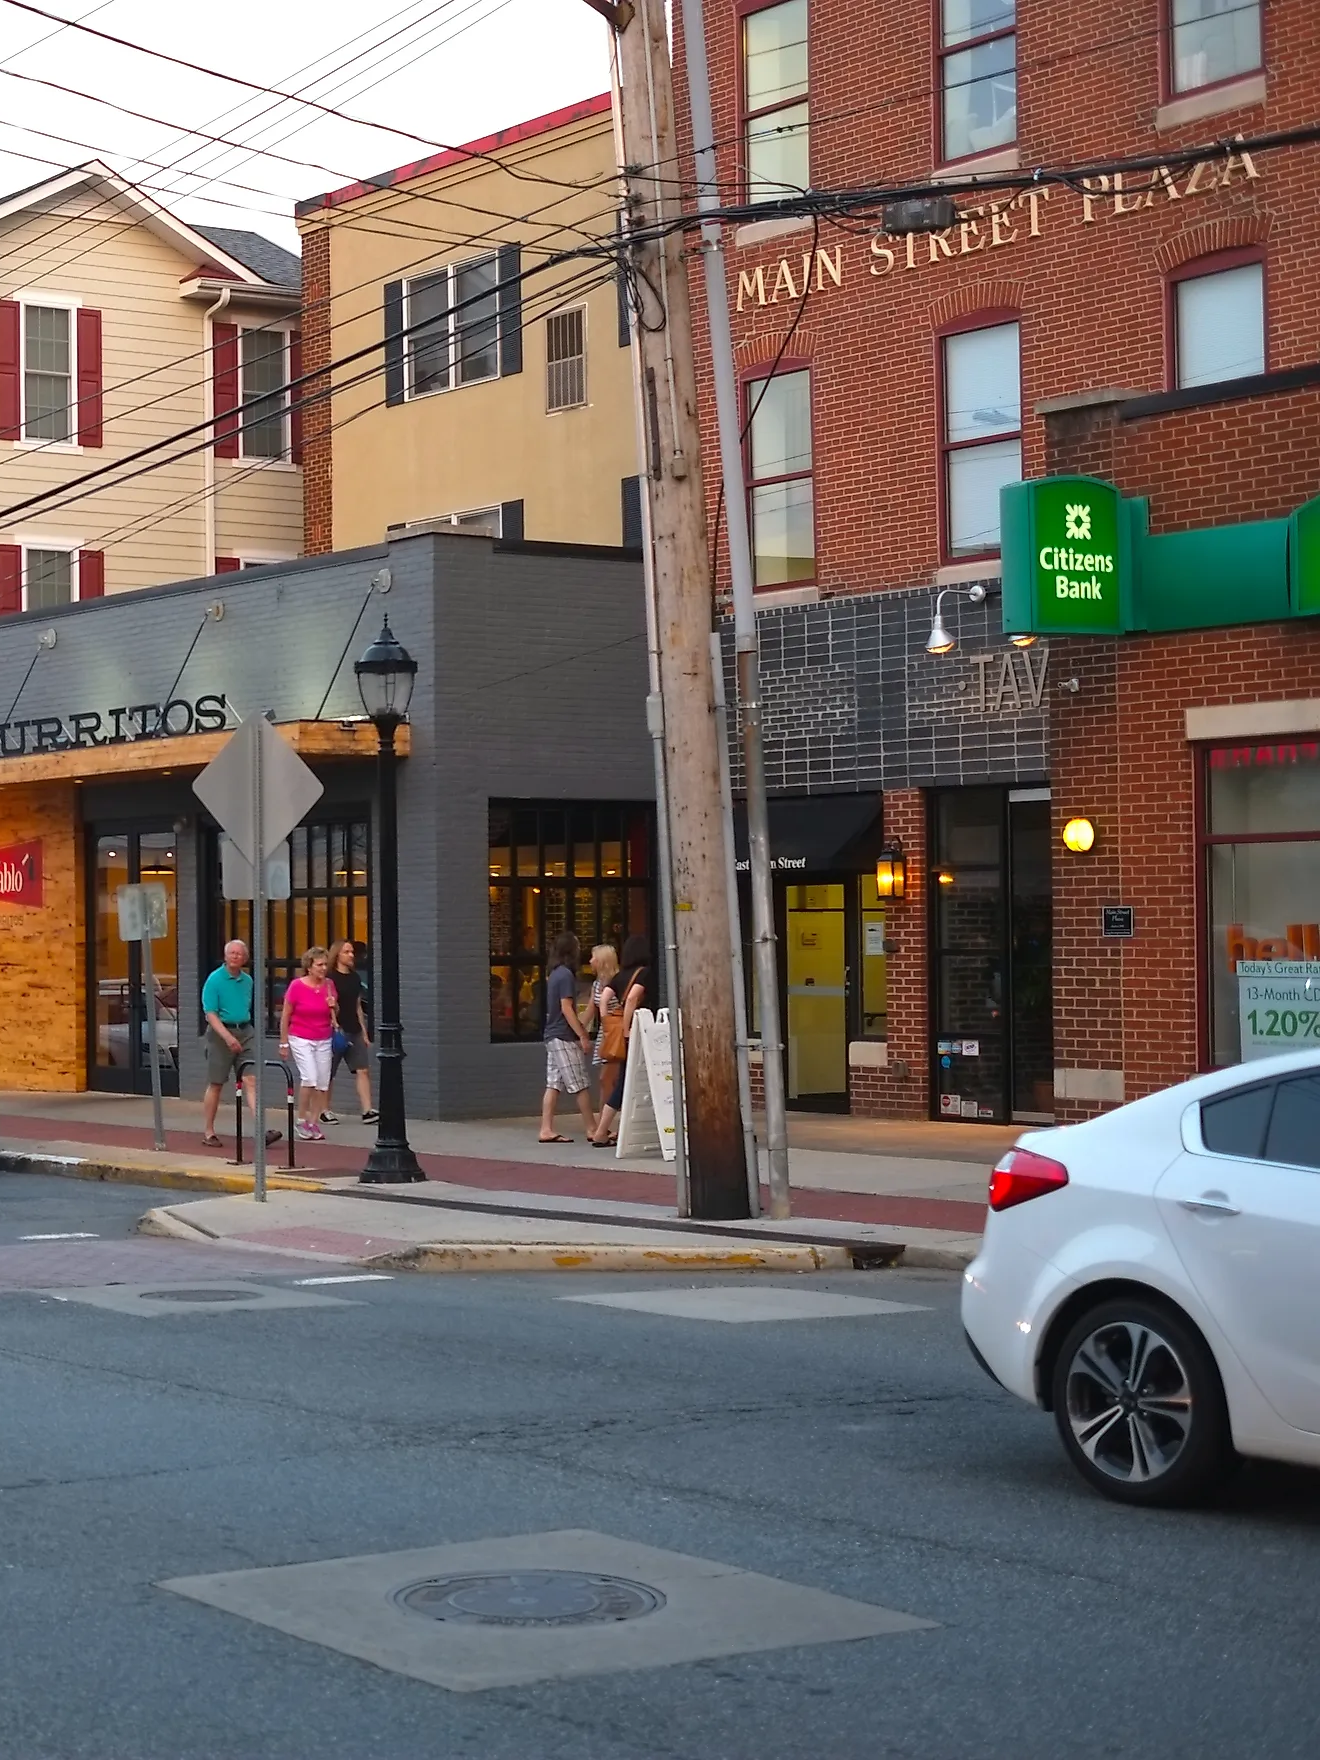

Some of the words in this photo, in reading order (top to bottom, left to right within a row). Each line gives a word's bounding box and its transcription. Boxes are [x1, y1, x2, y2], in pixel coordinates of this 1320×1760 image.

[735, 244, 844, 313] MAIN
[869, 188, 1049, 277] STREET
[1079, 132, 1260, 225] PLAZA
[1039, 547, 1114, 573] Citizens
[1055, 575, 1103, 600] Bank
[969, 648, 1050, 712] TAV
[735, 858, 750, 871] ast
[777, 857, 807, 869] Street
[1240, 961, 1272, 974] Today's
[1274, 962, 1303, 974] Great
[1247, 987, 1300, 1001] 13-Month
[1247, 1009, 1320, 1038] 1.20%
